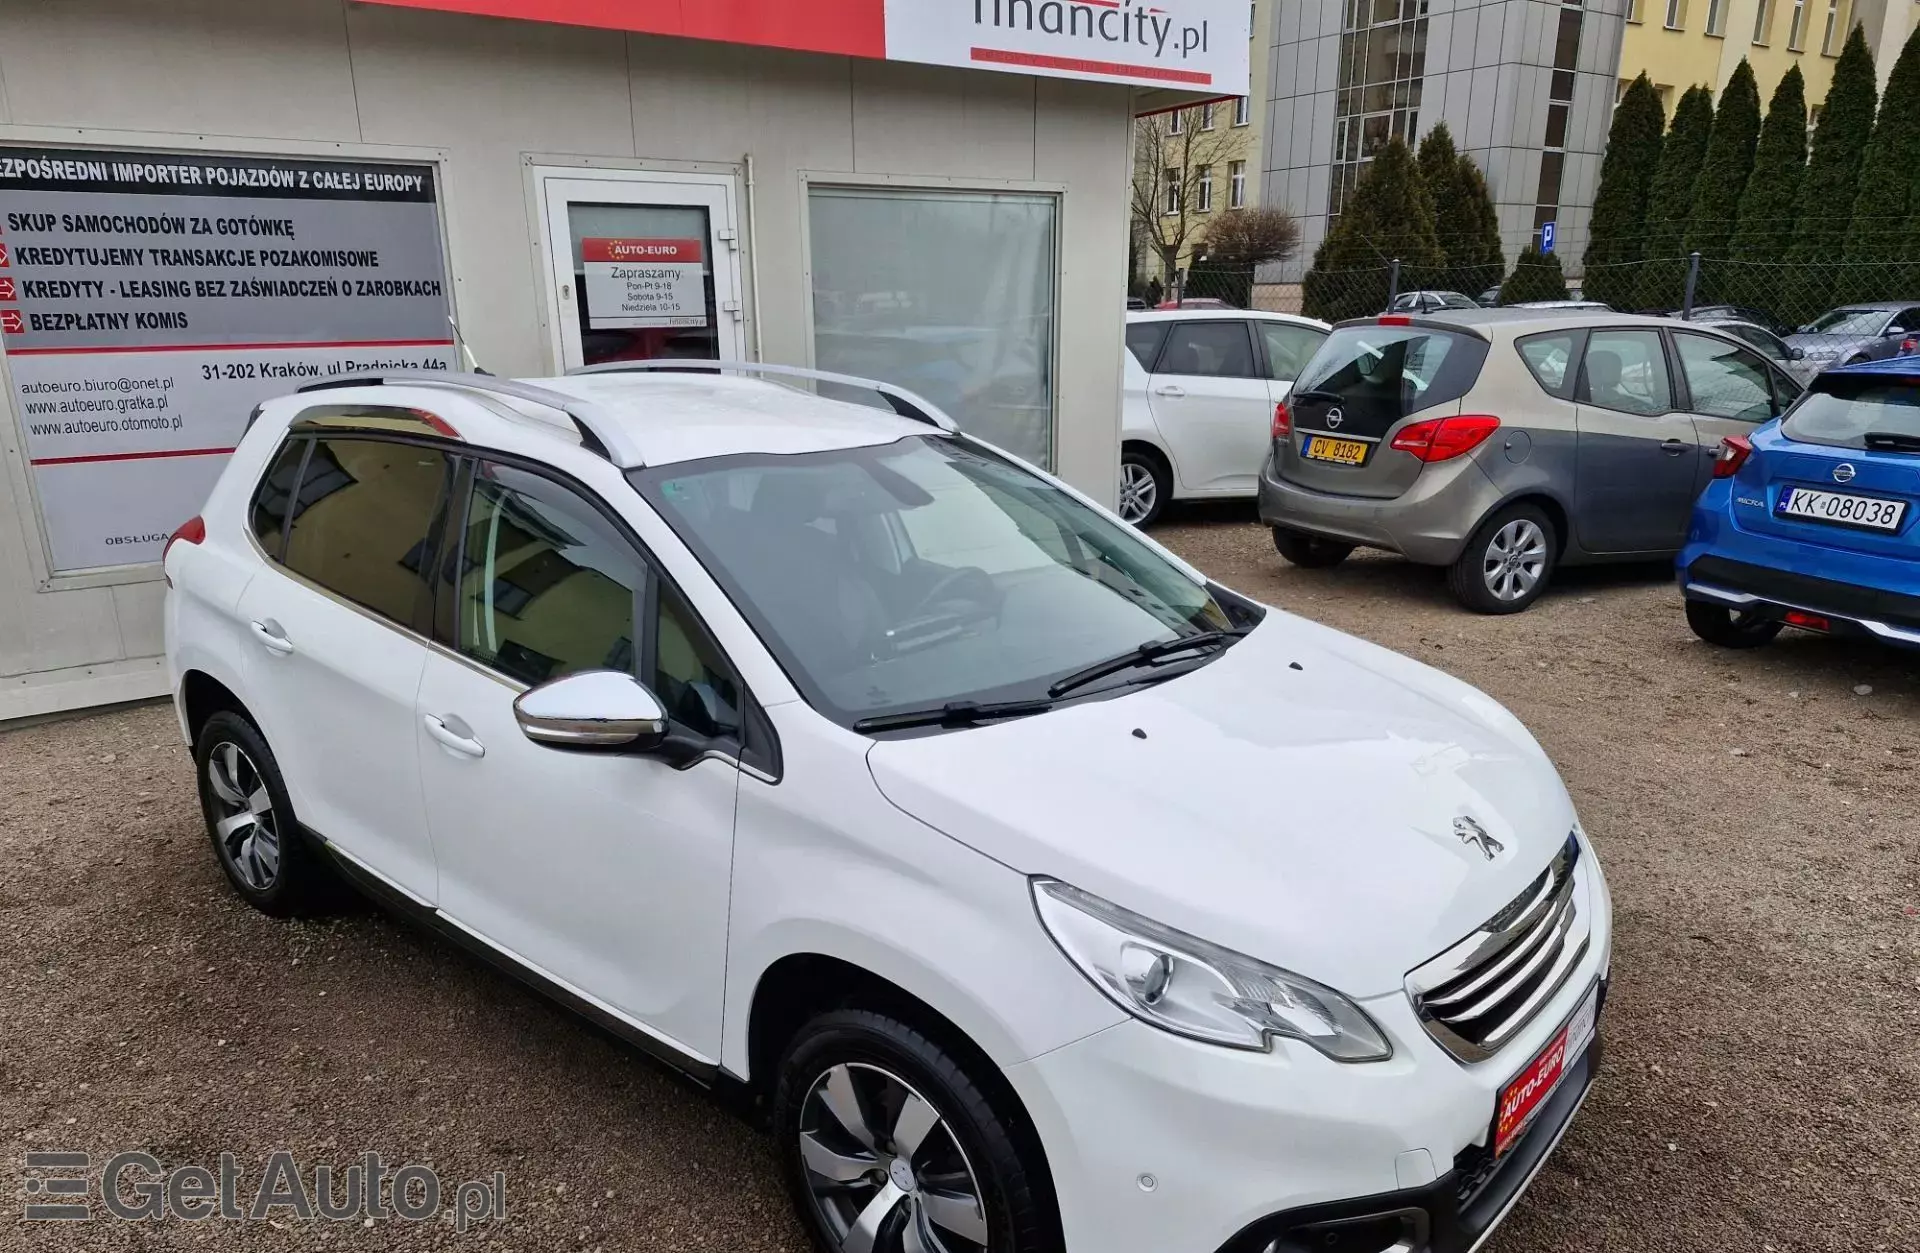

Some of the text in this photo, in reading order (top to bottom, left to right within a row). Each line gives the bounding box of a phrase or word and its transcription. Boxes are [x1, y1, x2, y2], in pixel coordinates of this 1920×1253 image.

[112, 162, 202, 185] IMPORTER
[205, 165, 294, 188] POJAZDÓW
[299, 171, 309, 188] Z
[313, 171, 361, 190] CAŁEJ
[365, 173, 423, 192] EUROPY
[8, 213, 295, 240] SKUP SAMOCHODÓW ZA GOTÓWKĘ
[1544, 226, 1552, 246] P
[15, 247, 378, 267] KREDYTUJEMY TRANSAKCJE POZAKOMISOWE
[615, 246, 677, 254] AUTO-EURO
[22, 281, 104, 298] KREDYTY
[120, 280, 191, 298] LEASING
[196, 280, 227, 298] BEZ
[230, 275, 338, 298] ZAŚWIADCZEŃ
[342, 280, 352, 297] O
[356, 280, 440, 297] ZAROBKACH
[626, 282, 672, 290] Pon-Pt 9-18
[621, 303, 657, 311] Niedziela
[627, 293, 654, 301] Sobota
[30, 312, 188, 331] BEZPŁATNY KOMIS
[201, 363, 256, 380] 31-202
[422, 358, 447, 370] 44a
[21, 377, 174, 395] autoeuro.biuro@onet.pl
[25, 396, 168, 414] www.autoeuro.gratka.pl
[30, 415, 183, 436] www.autoeuro.otomoto.pl
[1314, 440, 1331, 455] CV
[1333, 442, 1361, 460] 8182
[1791, 491, 1896, 525] KK 08038
[105, 533, 169, 545] OBSŁUGA
[1502, 1044, 1563, 1122] AUTO-EURO
